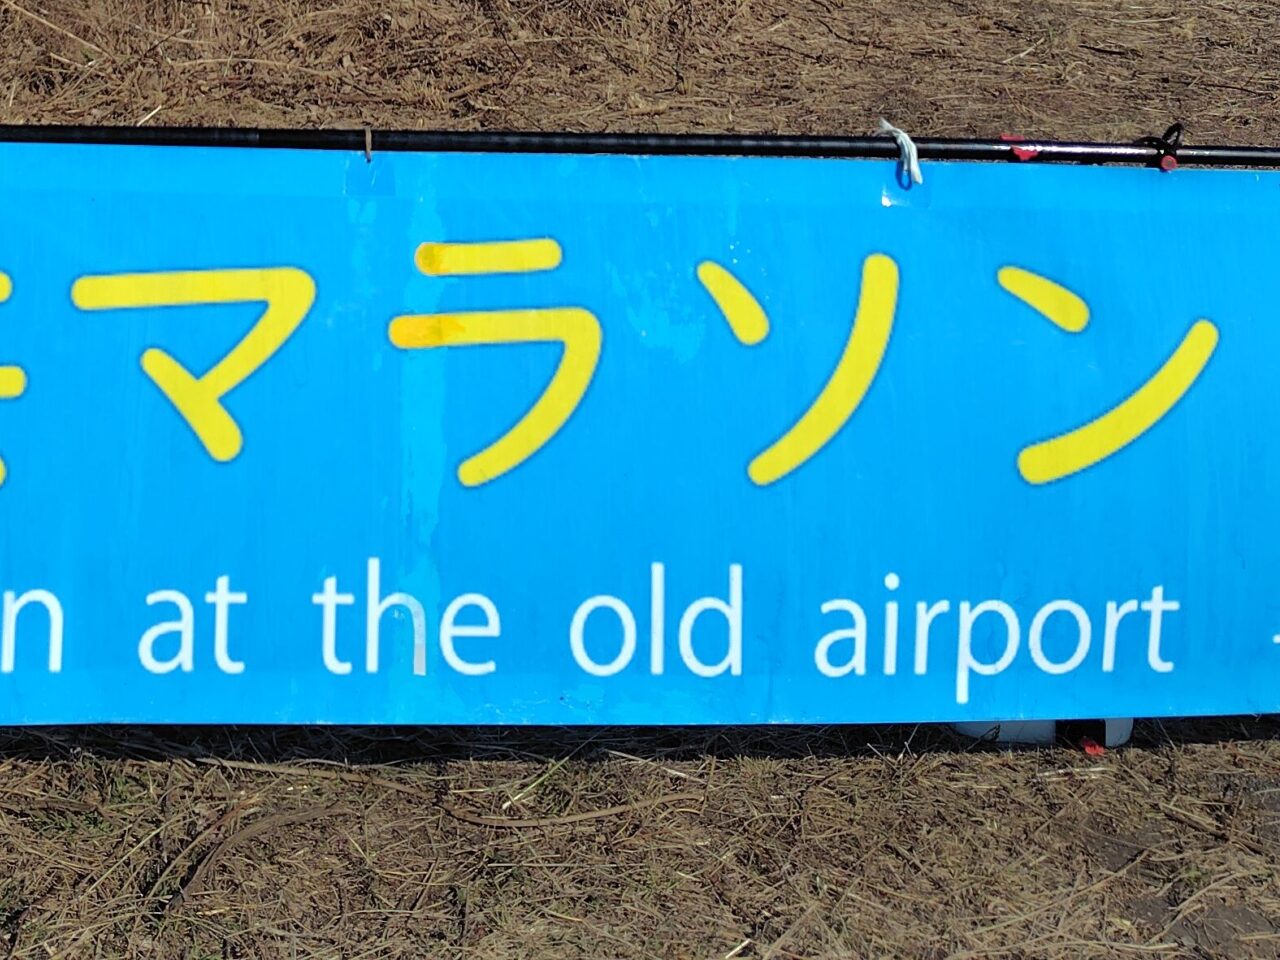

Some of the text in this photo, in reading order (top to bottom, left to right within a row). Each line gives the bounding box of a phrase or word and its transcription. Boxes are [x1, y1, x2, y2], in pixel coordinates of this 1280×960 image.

[138, 575, 247, 674] at
[312, 557, 501, 676] the
[569, 562, 743, 678] old
[814, 571, 1179, 705] airport
